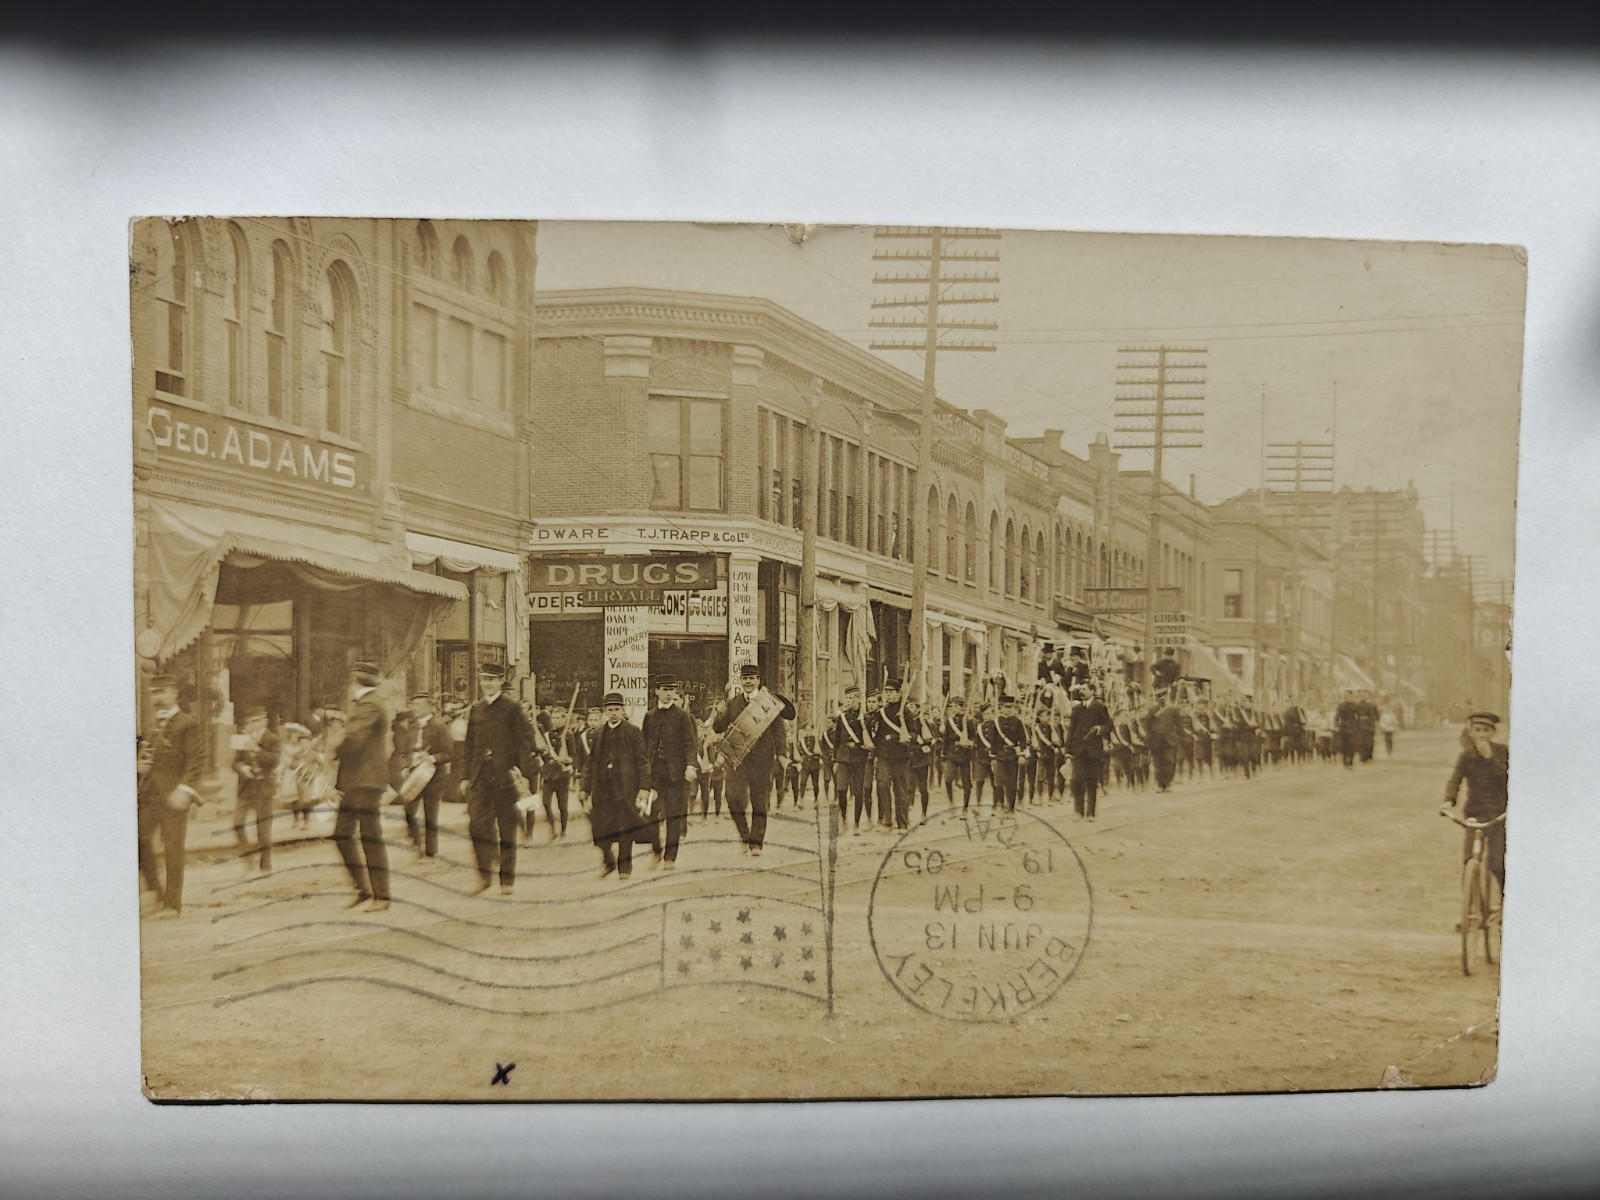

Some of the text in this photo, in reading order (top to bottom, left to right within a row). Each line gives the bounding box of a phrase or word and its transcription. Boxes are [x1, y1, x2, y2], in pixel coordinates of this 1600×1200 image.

[713, 533, 720, 541] &
[924, 921, 1042, 951] JUN 13
